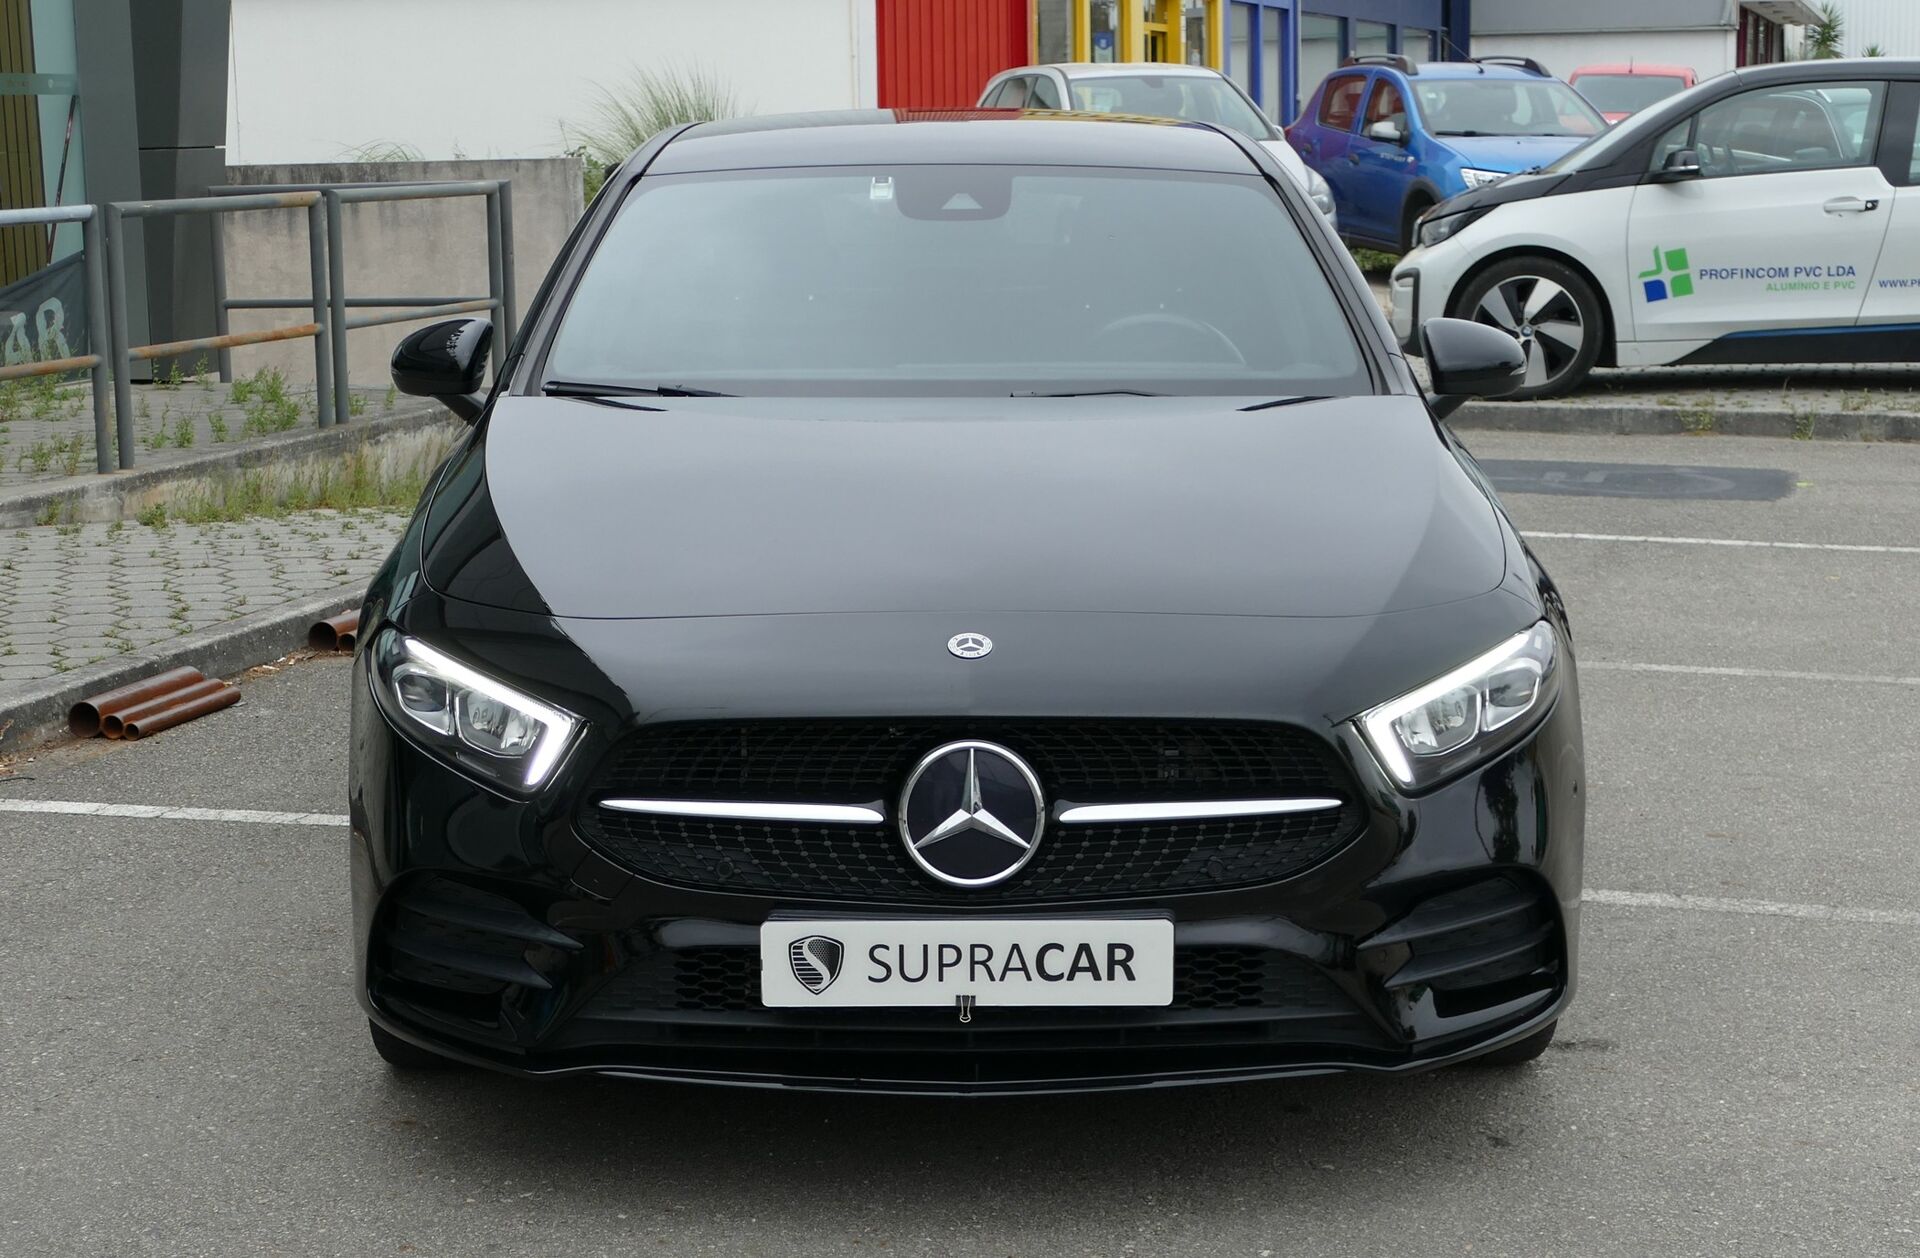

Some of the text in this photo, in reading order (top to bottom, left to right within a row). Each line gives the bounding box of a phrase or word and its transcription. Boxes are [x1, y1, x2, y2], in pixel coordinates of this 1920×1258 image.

[1699, 265, 1856, 280] PROFINCOM PVC LDA
[1823, 281, 1831, 290] E
[1833, 280, 1856, 290] PVC
[867, 942, 1137, 983] SUPRACAR
